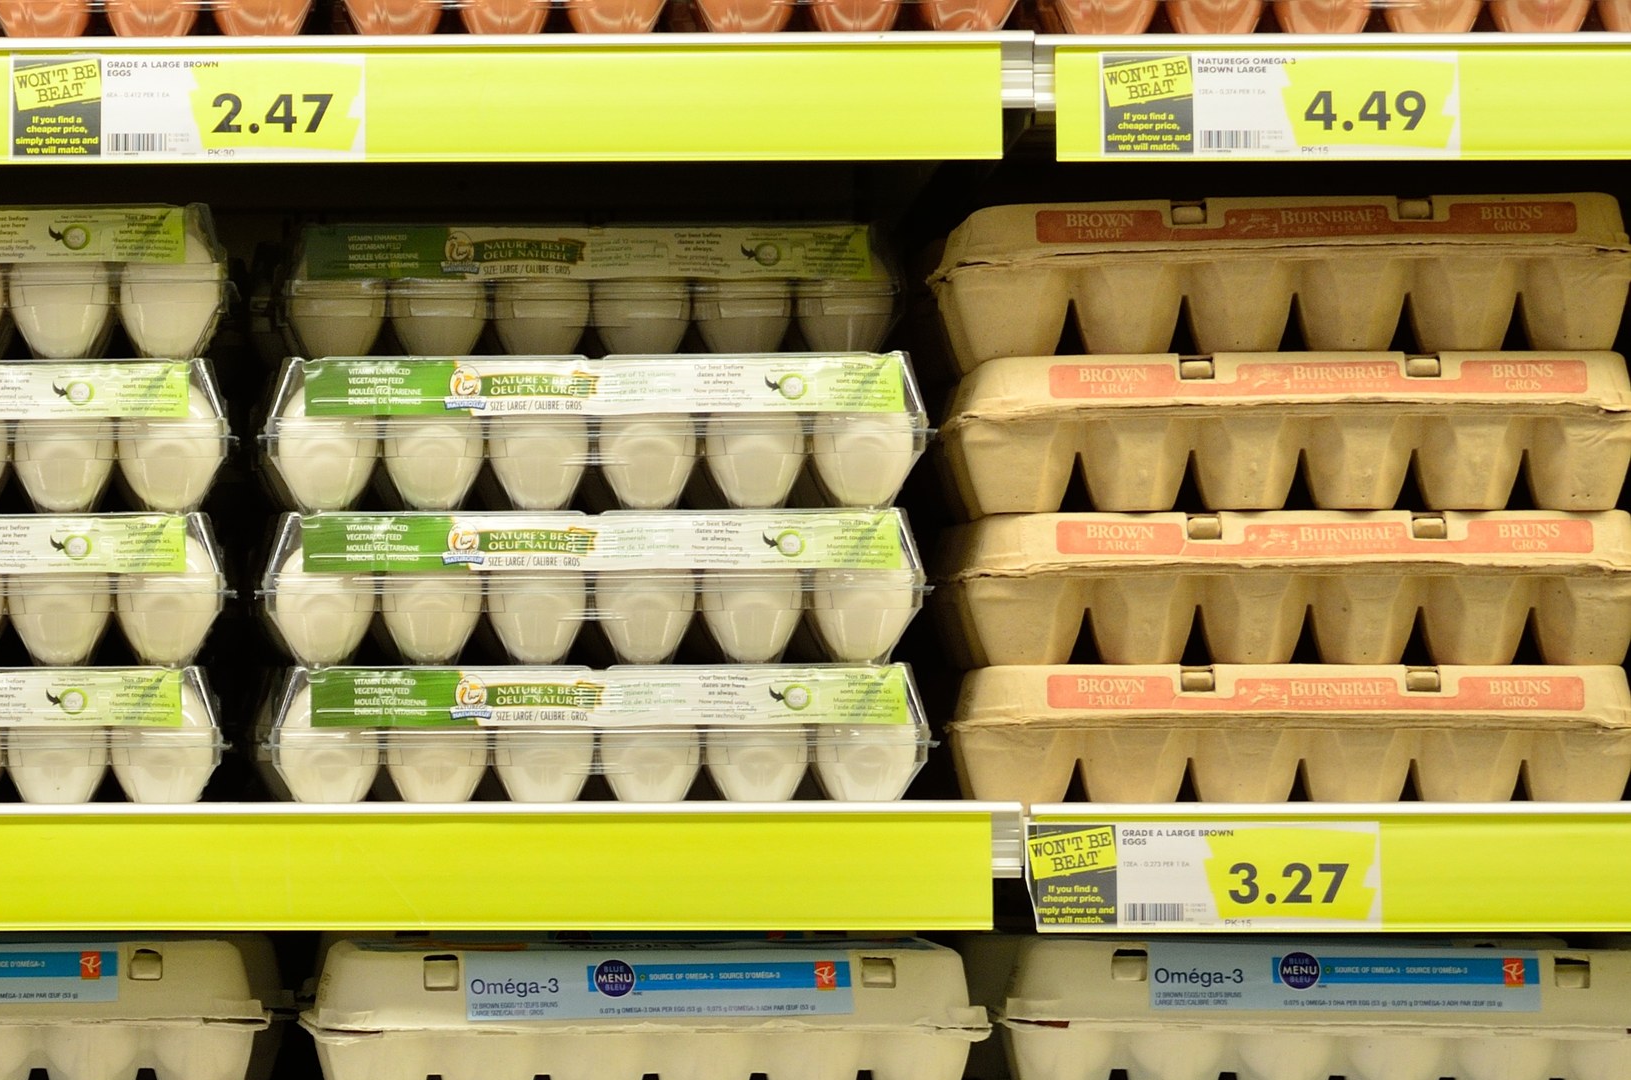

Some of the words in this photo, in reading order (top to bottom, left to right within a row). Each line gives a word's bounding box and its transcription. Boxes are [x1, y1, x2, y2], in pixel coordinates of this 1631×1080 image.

[16, 68, 68, 89] WON'T
[73, 64, 97, 81] BE
[1106, 65, 1158, 86] WON'T
[1164, 60, 1187, 76] BE
[36, 82, 84, 103] BEAT
[1127, 78, 1174, 100] BEAT
[211, 93, 334, 134] 2.47
[1305, 90, 1426, 131] 4.49
[26, 125, 61, 135] cheaper
[32, 116, 39, 124] If
[40, 117, 56, 126] you
[58, 116, 74, 124] find
[16, 137, 43, 146] simply
[45, 137, 68, 145] show
[82, 137, 99, 145] and
[41, 146, 56, 154] will
[1086, 524, 1154, 540] BROWN
[1300, 526, 1394, 542] BURNBRAE
[1499, 522, 1560, 539] BRUNS
[1097, 539, 1144, 552] LARGE
[1511, 538, 1547, 551] GROS
[1122, 829, 1154, 837] GRADE
[1156, 829, 1163, 837] A
[1166, 829, 1195, 837] LARGE
[1198, 829, 1234, 837] BROWN
[1030, 836, 1083, 857] WON'T
[1090, 832, 1111, 847] BE
[1052, 850, 1099, 871] BEAT
[1229, 862, 1350, 904] 3.27
[470, 978, 560, 997] Oméga-3
[1154, 968, 1243, 987] Oméga-3
